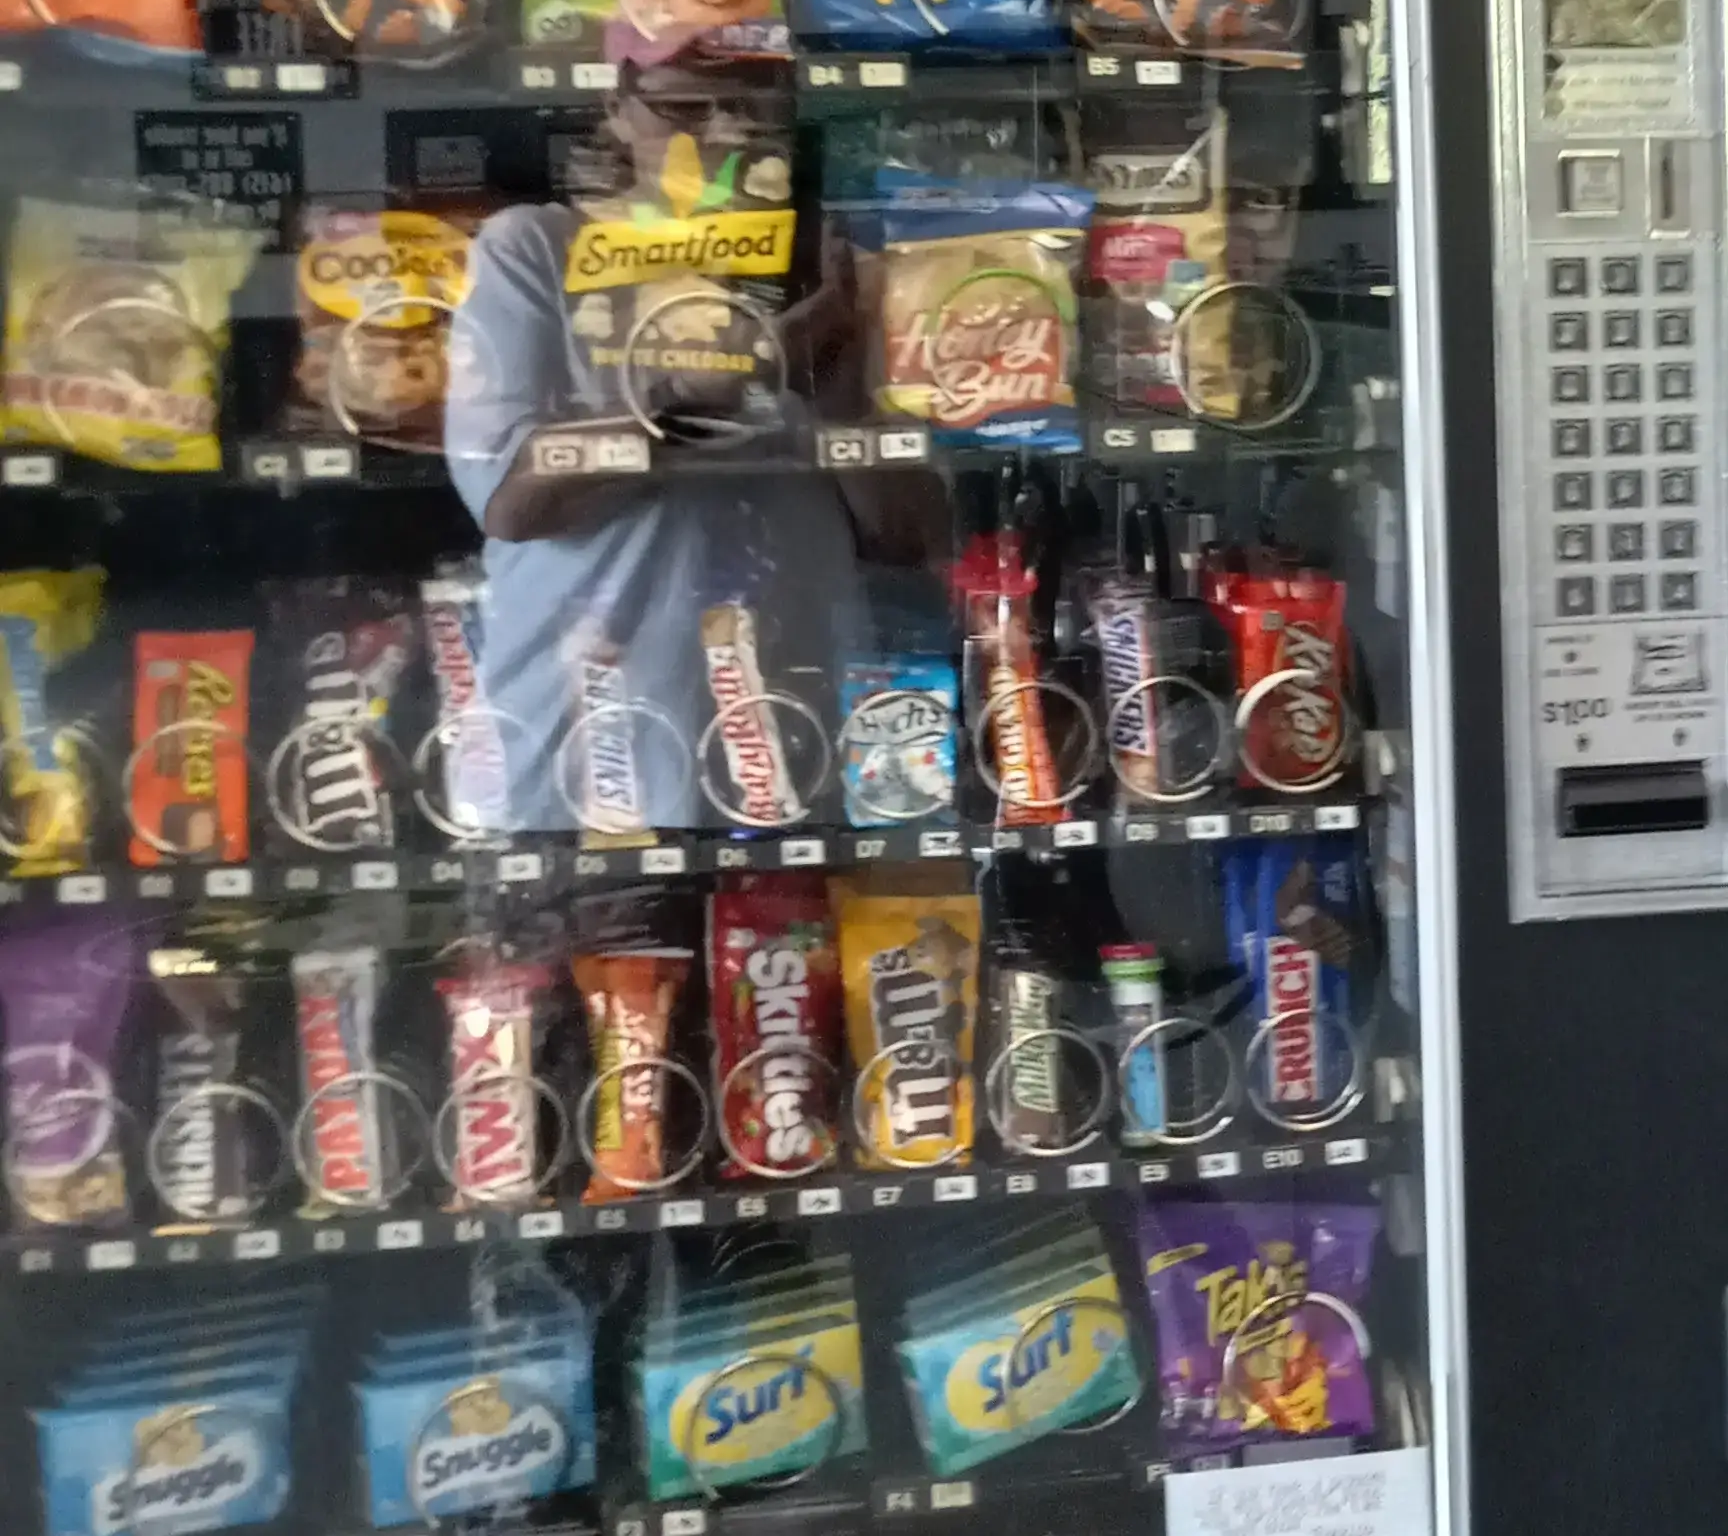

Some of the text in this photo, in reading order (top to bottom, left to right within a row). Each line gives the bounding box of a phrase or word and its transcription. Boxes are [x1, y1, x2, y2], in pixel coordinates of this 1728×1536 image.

[578, 220, 778, 278] Smartfood
[932, 360, 1048, 422] Bun
[581, 666, 635, 810] SNICRS
[1101, 613, 1151, 754] SNICKERS
[746, 949, 815, 1163] Skittles
[868, 944, 954, 1150] m&m's
[1271, 942, 1318, 1103] CRUNCH
[705, 1342, 813, 1446] Surf
[975, 1308, 1076, 1414] Surf
[421, 1419, 555, 1490] Snuggle
